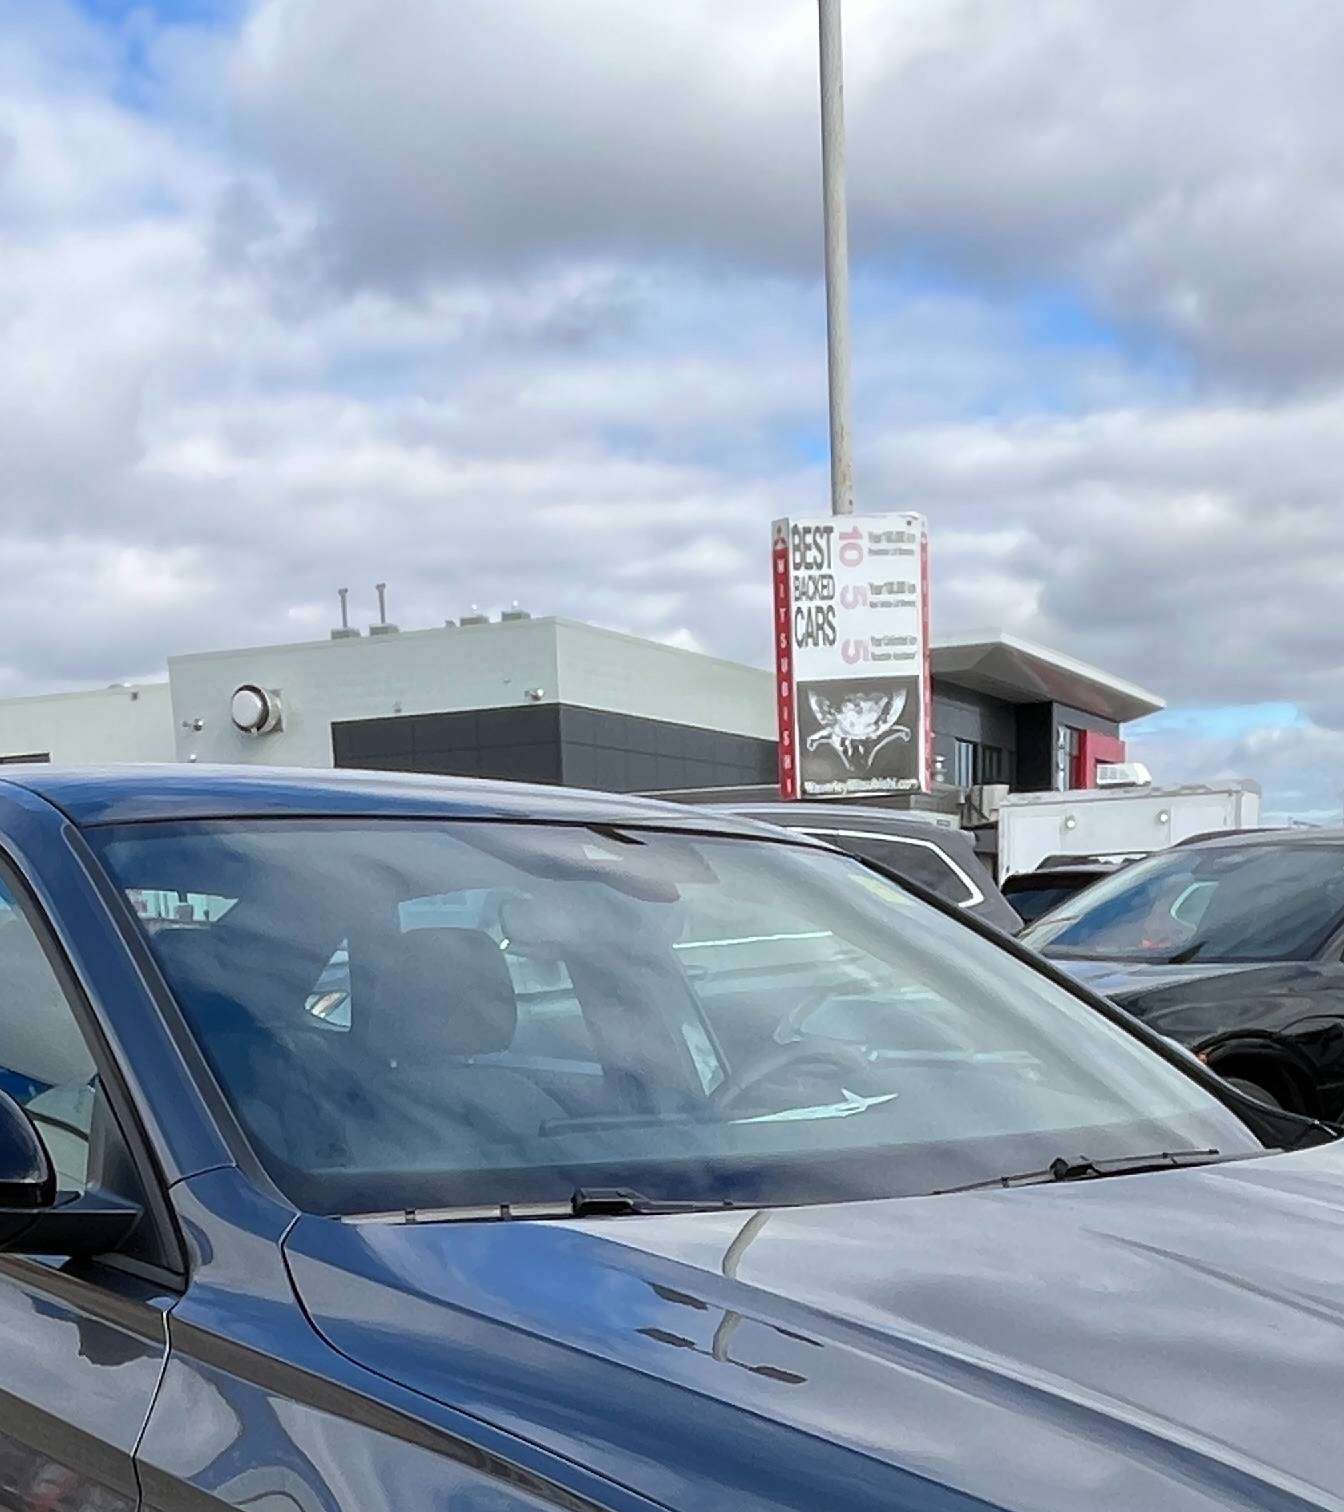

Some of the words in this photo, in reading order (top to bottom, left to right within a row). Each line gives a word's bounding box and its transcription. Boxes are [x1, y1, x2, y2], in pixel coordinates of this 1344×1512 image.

[792, 524, 834, 571] BEST
[839, 525, 863, 567] 10
[794, 574, 835, 601] BACKED
[794, 604, 836, 648] CARS
[775, 558, 793, 794] MITSUBISHI
